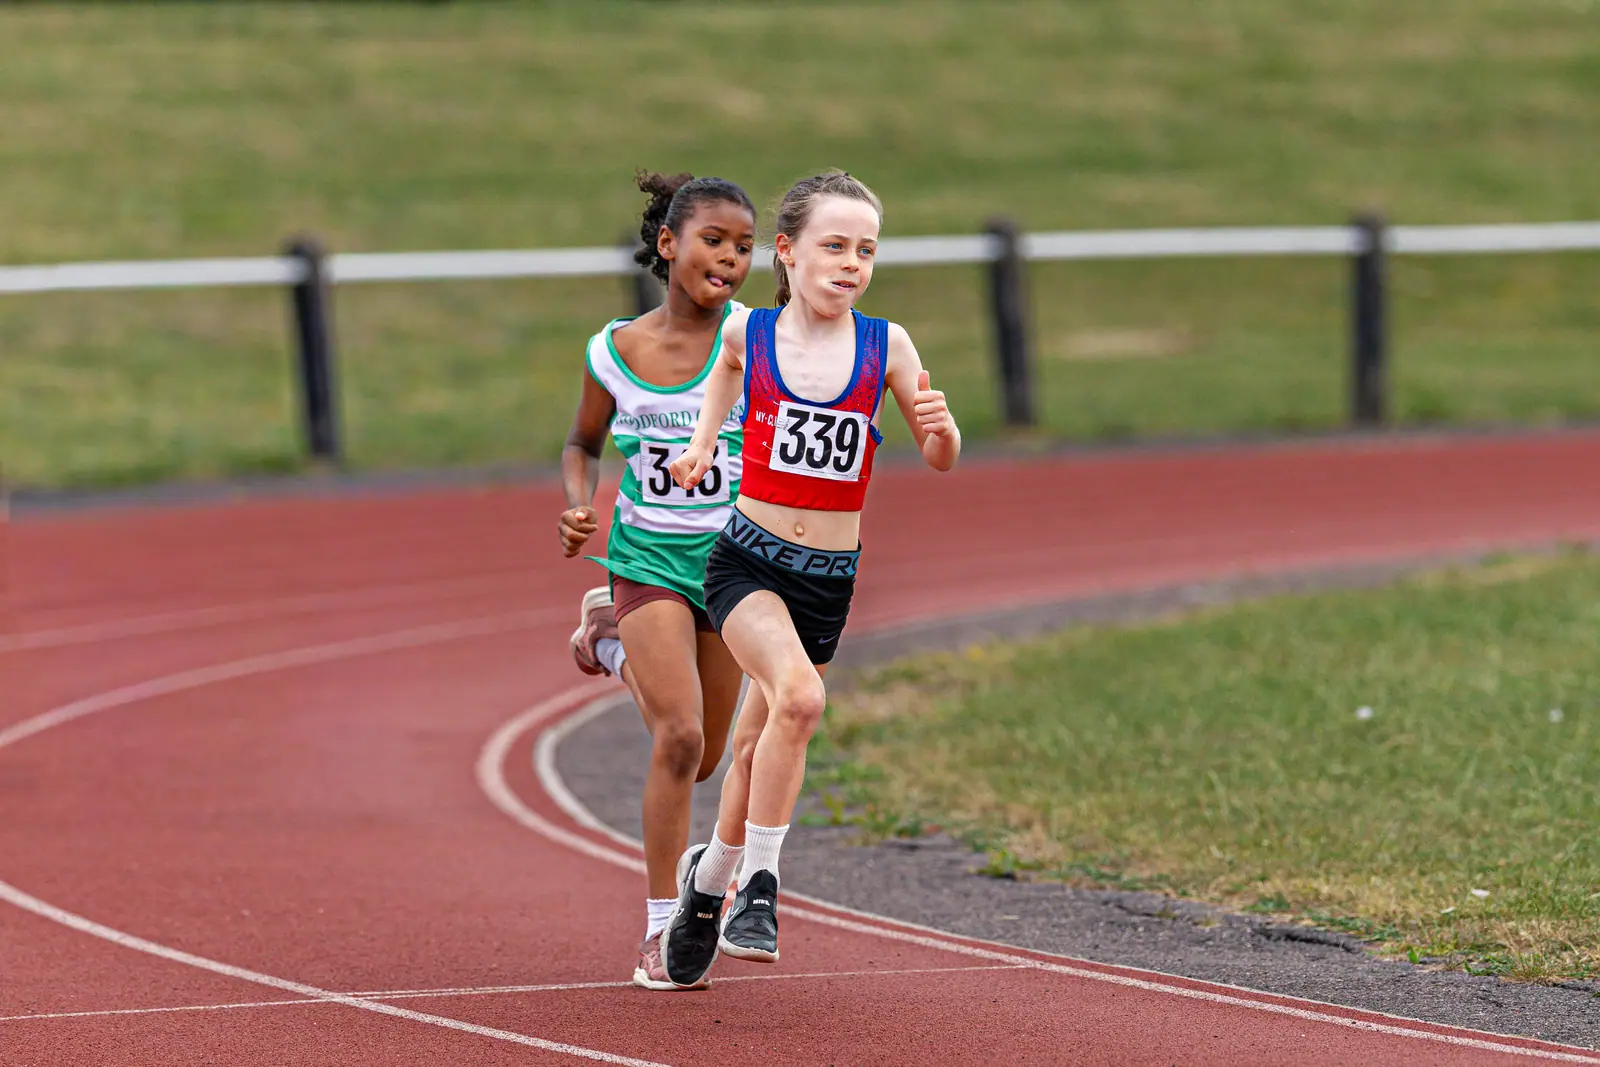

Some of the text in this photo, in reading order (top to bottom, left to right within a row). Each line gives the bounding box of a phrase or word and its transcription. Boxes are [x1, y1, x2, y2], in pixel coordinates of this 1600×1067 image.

[779, 408, 861, 473] 339
[648, 445, 722, 498] 36
[724, 514, 803, 568] NIKE
